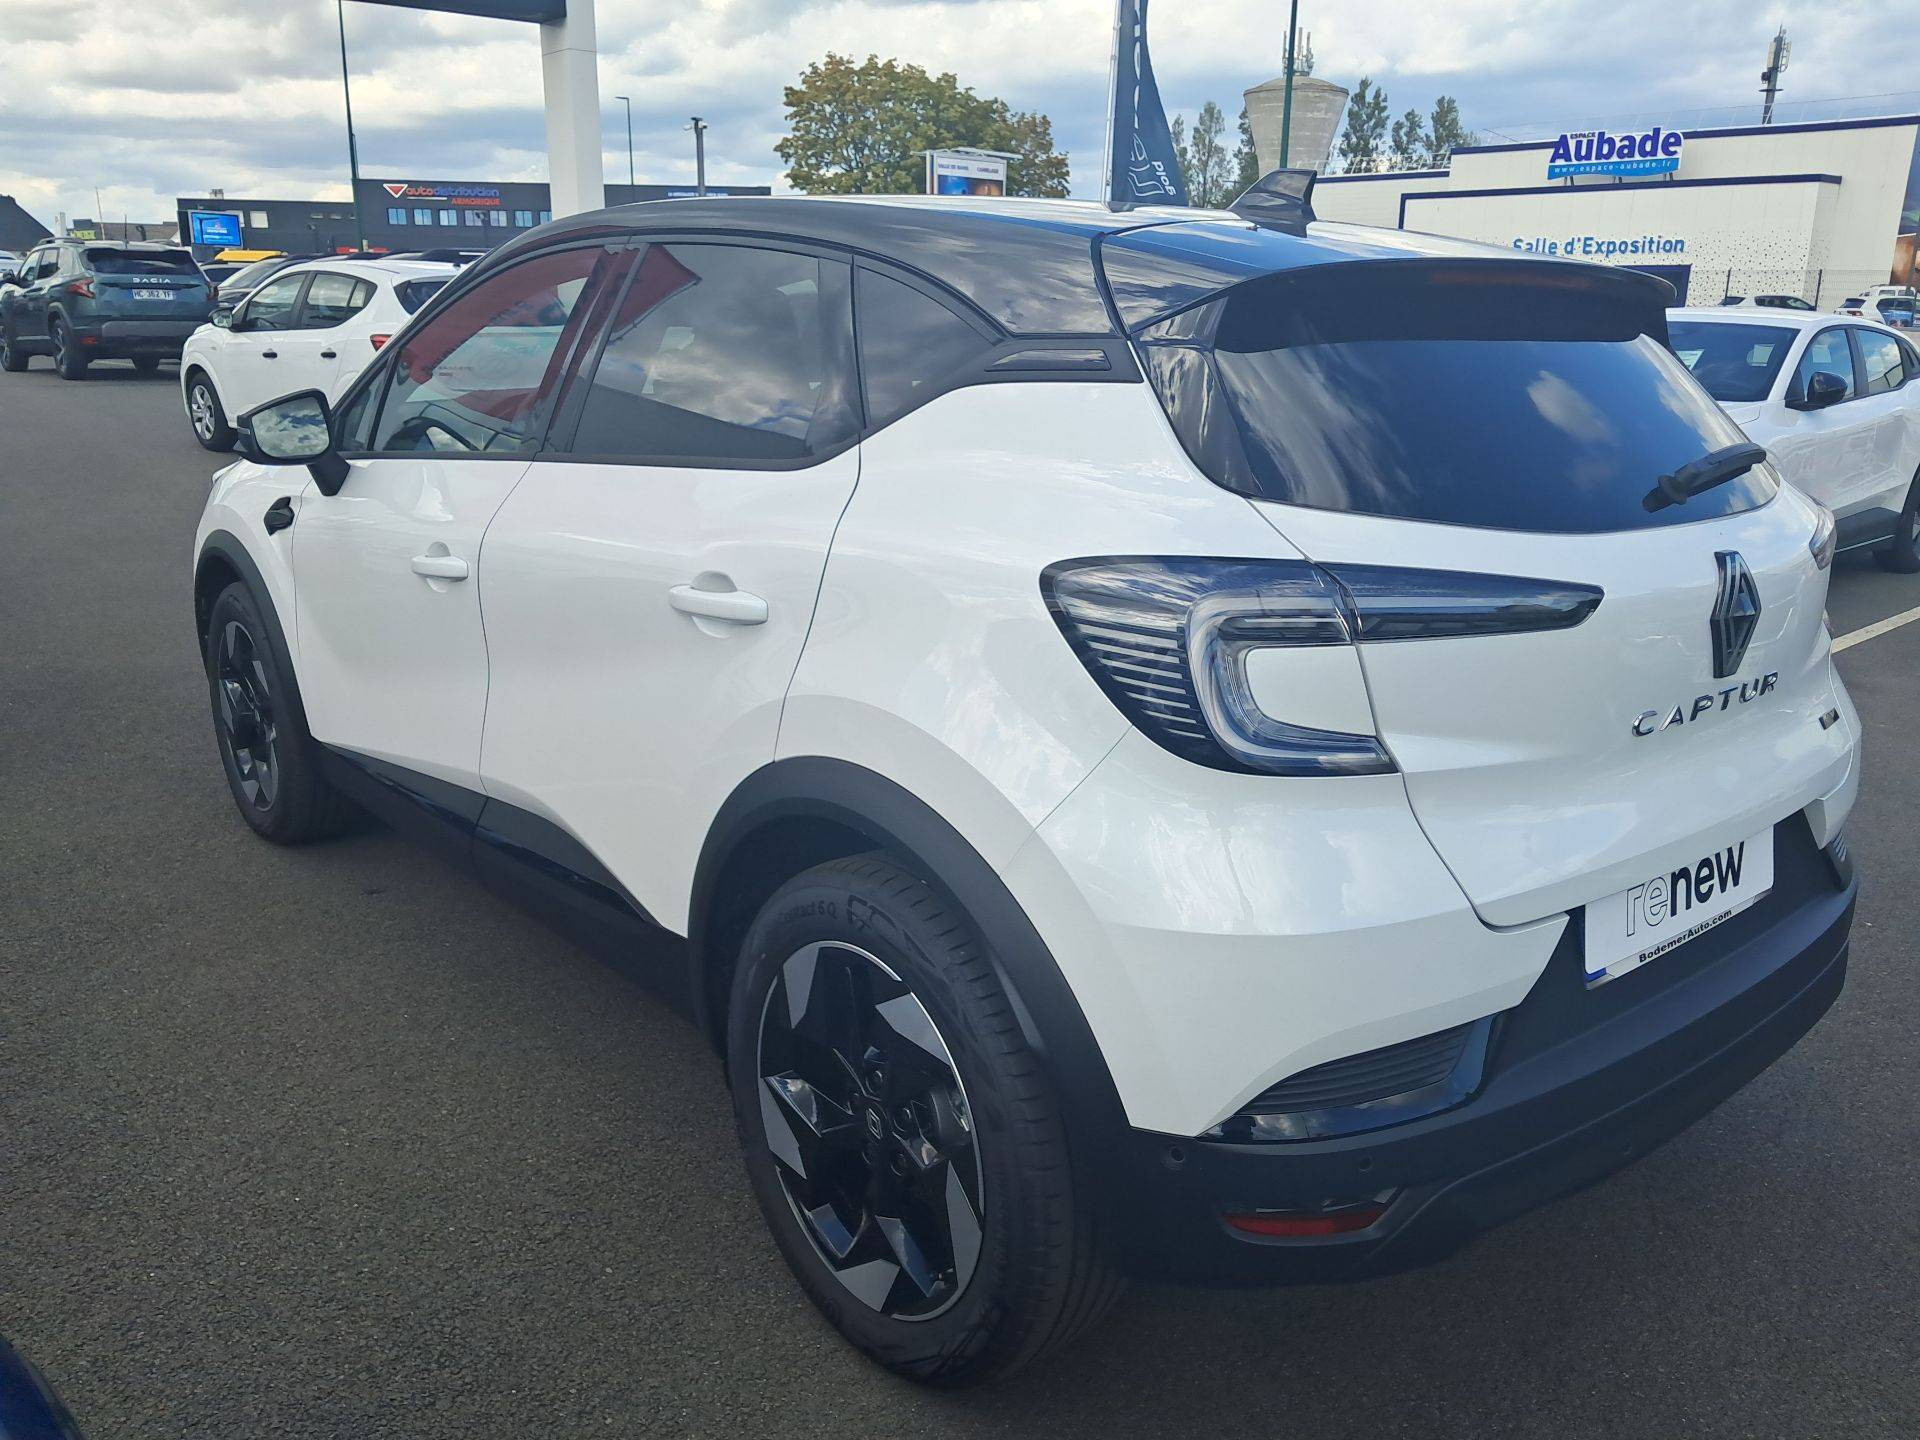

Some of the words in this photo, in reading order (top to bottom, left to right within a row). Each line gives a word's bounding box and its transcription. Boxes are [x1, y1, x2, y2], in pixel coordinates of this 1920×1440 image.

[1549, 127, 1682, 163] Aubade
[1554, 160, 1671, 173] www.espace-aubade.fr
[1513, 237, 1557, 255] Salle
[1564, 236, 1685, 258] d'Exposition
[1631, 671, 1779, 737] CAPTUR
[1626, 841, 1744, 937] renew
[1638, 909, 1733, 963] BodemerAuto.com
